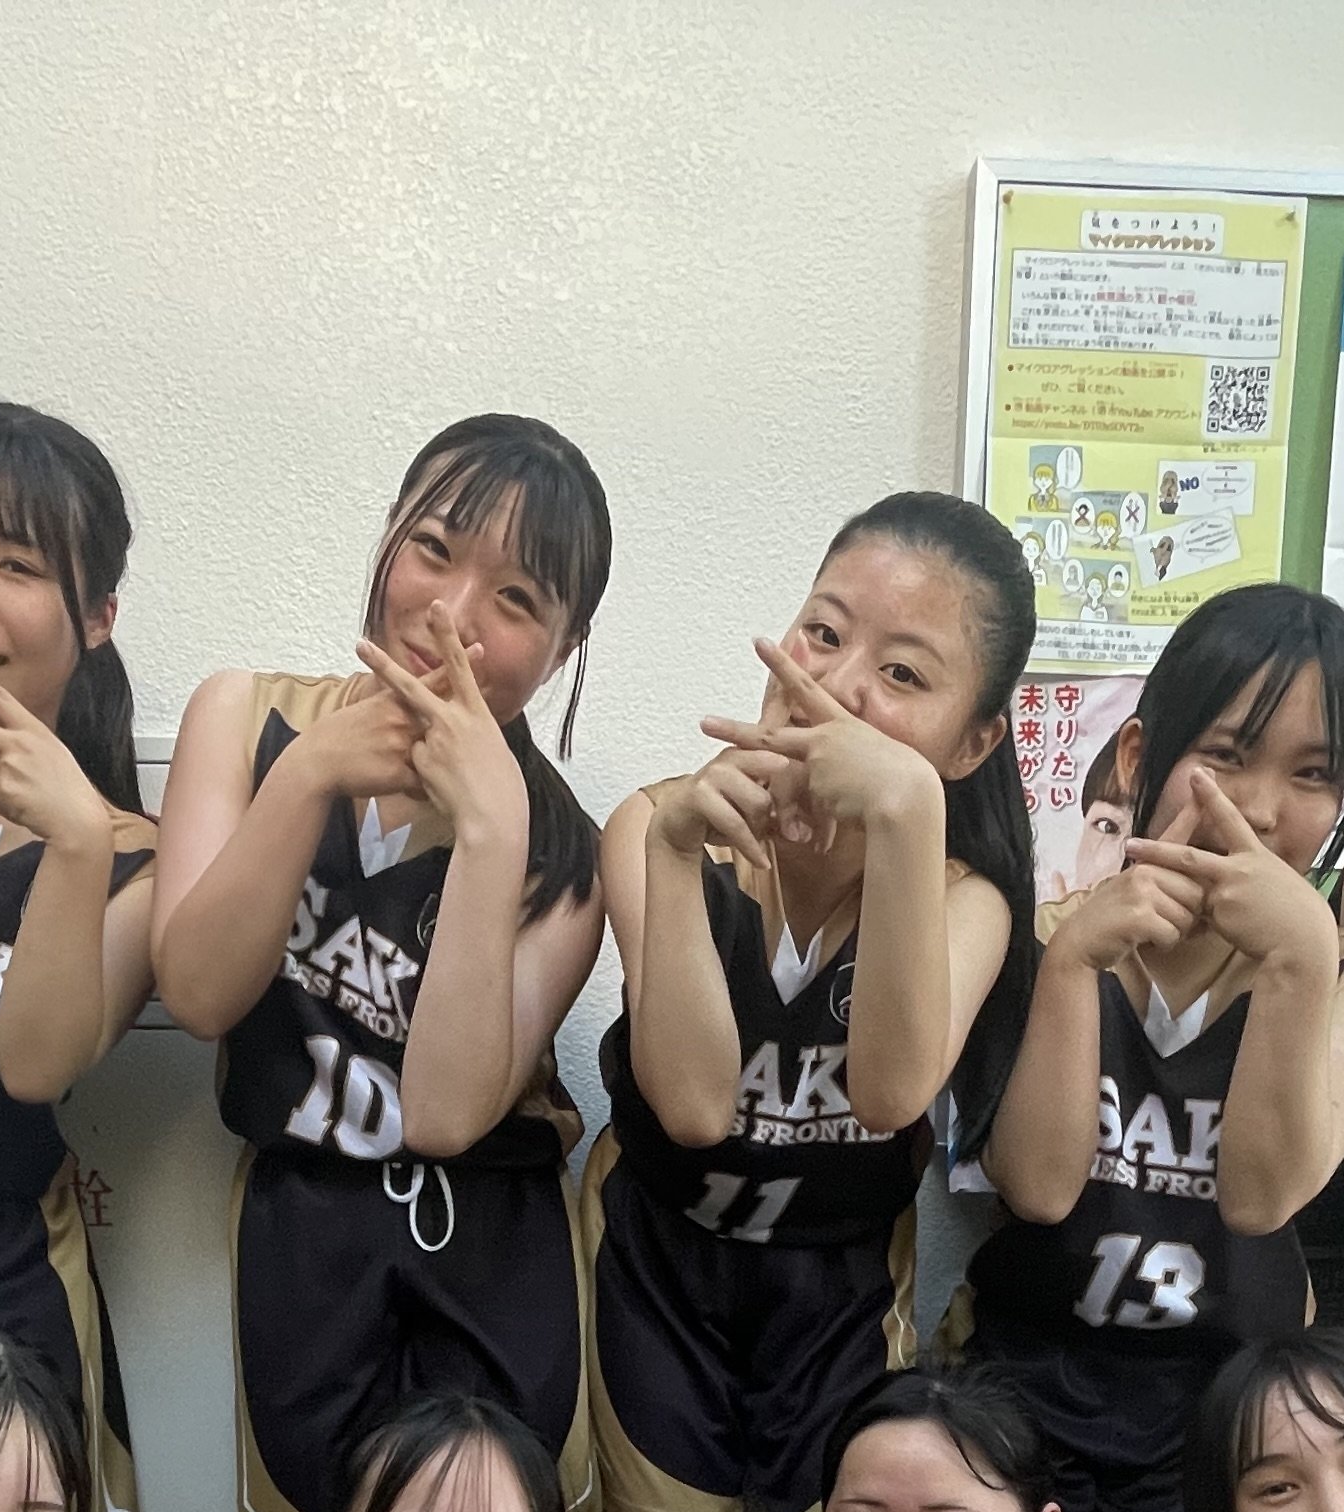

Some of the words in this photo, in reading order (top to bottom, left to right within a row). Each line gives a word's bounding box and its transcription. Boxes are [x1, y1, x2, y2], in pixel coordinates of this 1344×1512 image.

[1179, 476, 1200, 492] NO
[1050, 684, 1080, 807] 守りたい
[283, 1034, 404, 1160] 10
[684, 1171, 804, 1244] 11
[1072, 1232, 1206, 1330] 13
